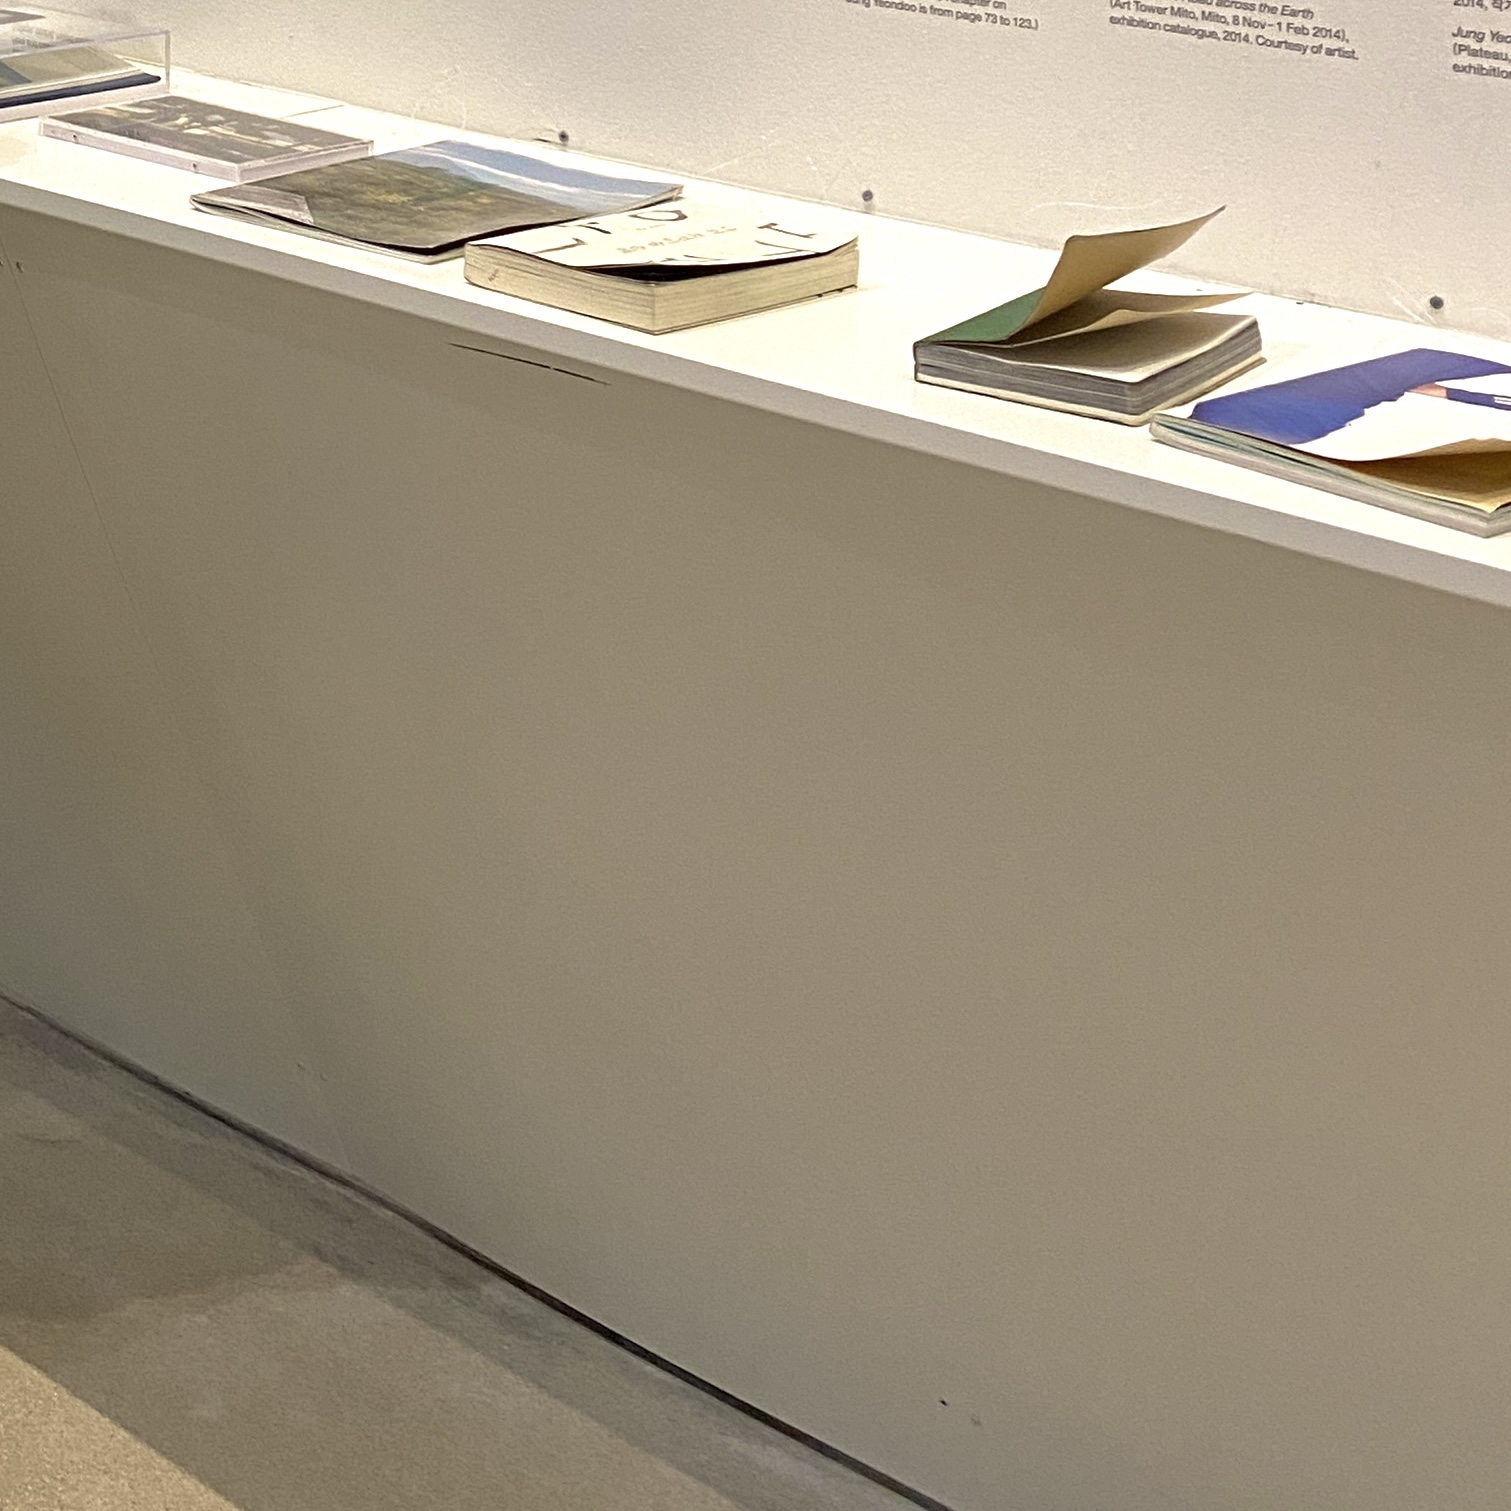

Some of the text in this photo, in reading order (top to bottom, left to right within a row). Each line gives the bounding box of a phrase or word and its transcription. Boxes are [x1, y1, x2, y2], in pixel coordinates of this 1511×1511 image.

[929, 5, 953, 17] from
[955, 11, 982, 23] page
[1133, 0, 1168, 15] Tower
[1232, 15, 1240, 26] 8
[1286, 22, 1309, 36] Feb
[1258, 3, 1278, 14] the
[1280, 5, 1314, 20] Earth
[1451, 26, 1486, 43] Jung
[1310, 43, 1323, 54] of
